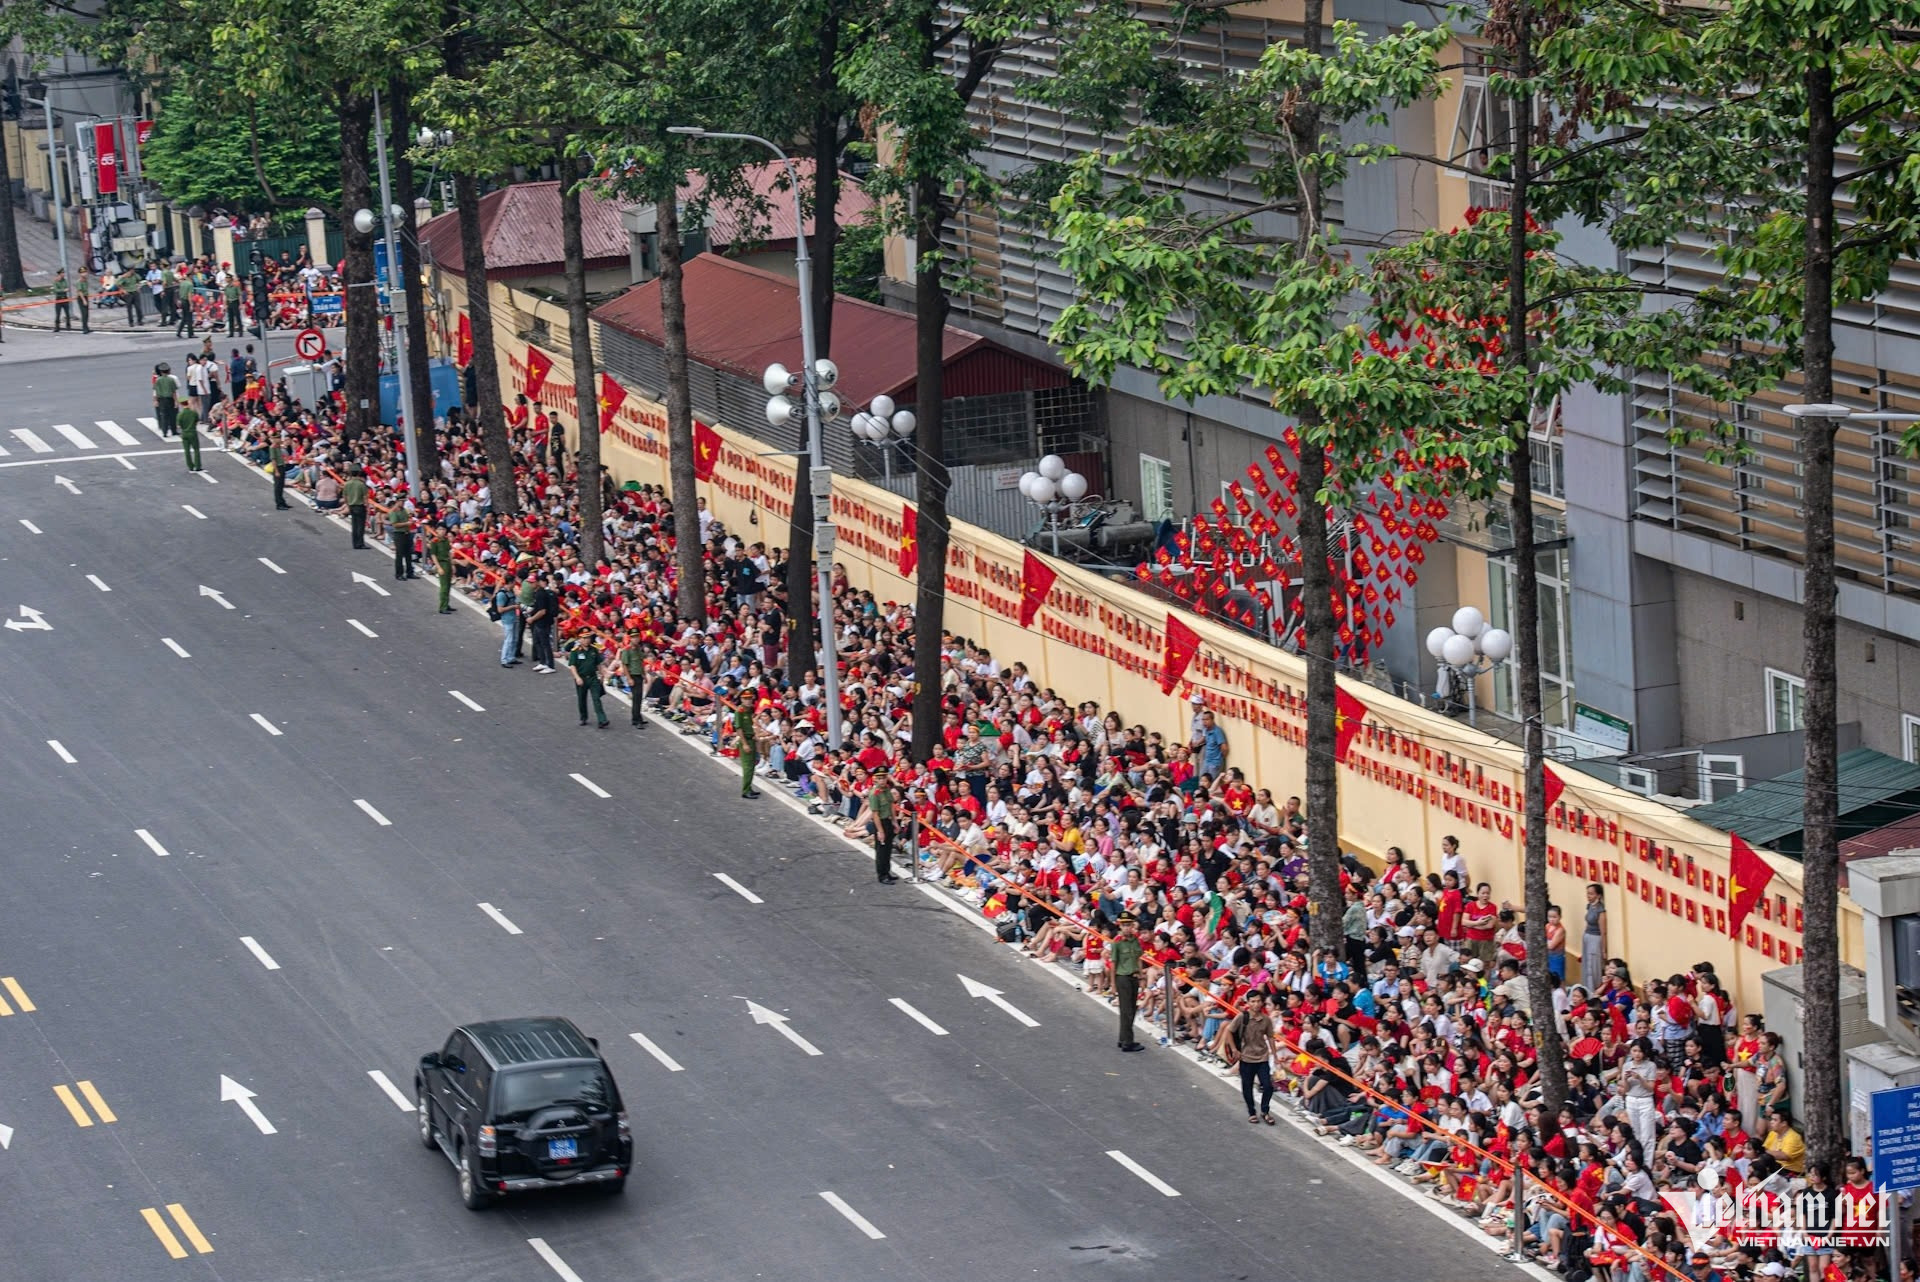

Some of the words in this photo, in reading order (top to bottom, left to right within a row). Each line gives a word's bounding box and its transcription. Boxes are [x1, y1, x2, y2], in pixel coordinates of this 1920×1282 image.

[1878, 1127, 1904, 1136] TRUNG
[1879, 1137, 1902, 1146] CENTRE
[1891, 1156, 1917, 1166] TRUNG
[1892, 1165, 1916, 1175] CENTRE
